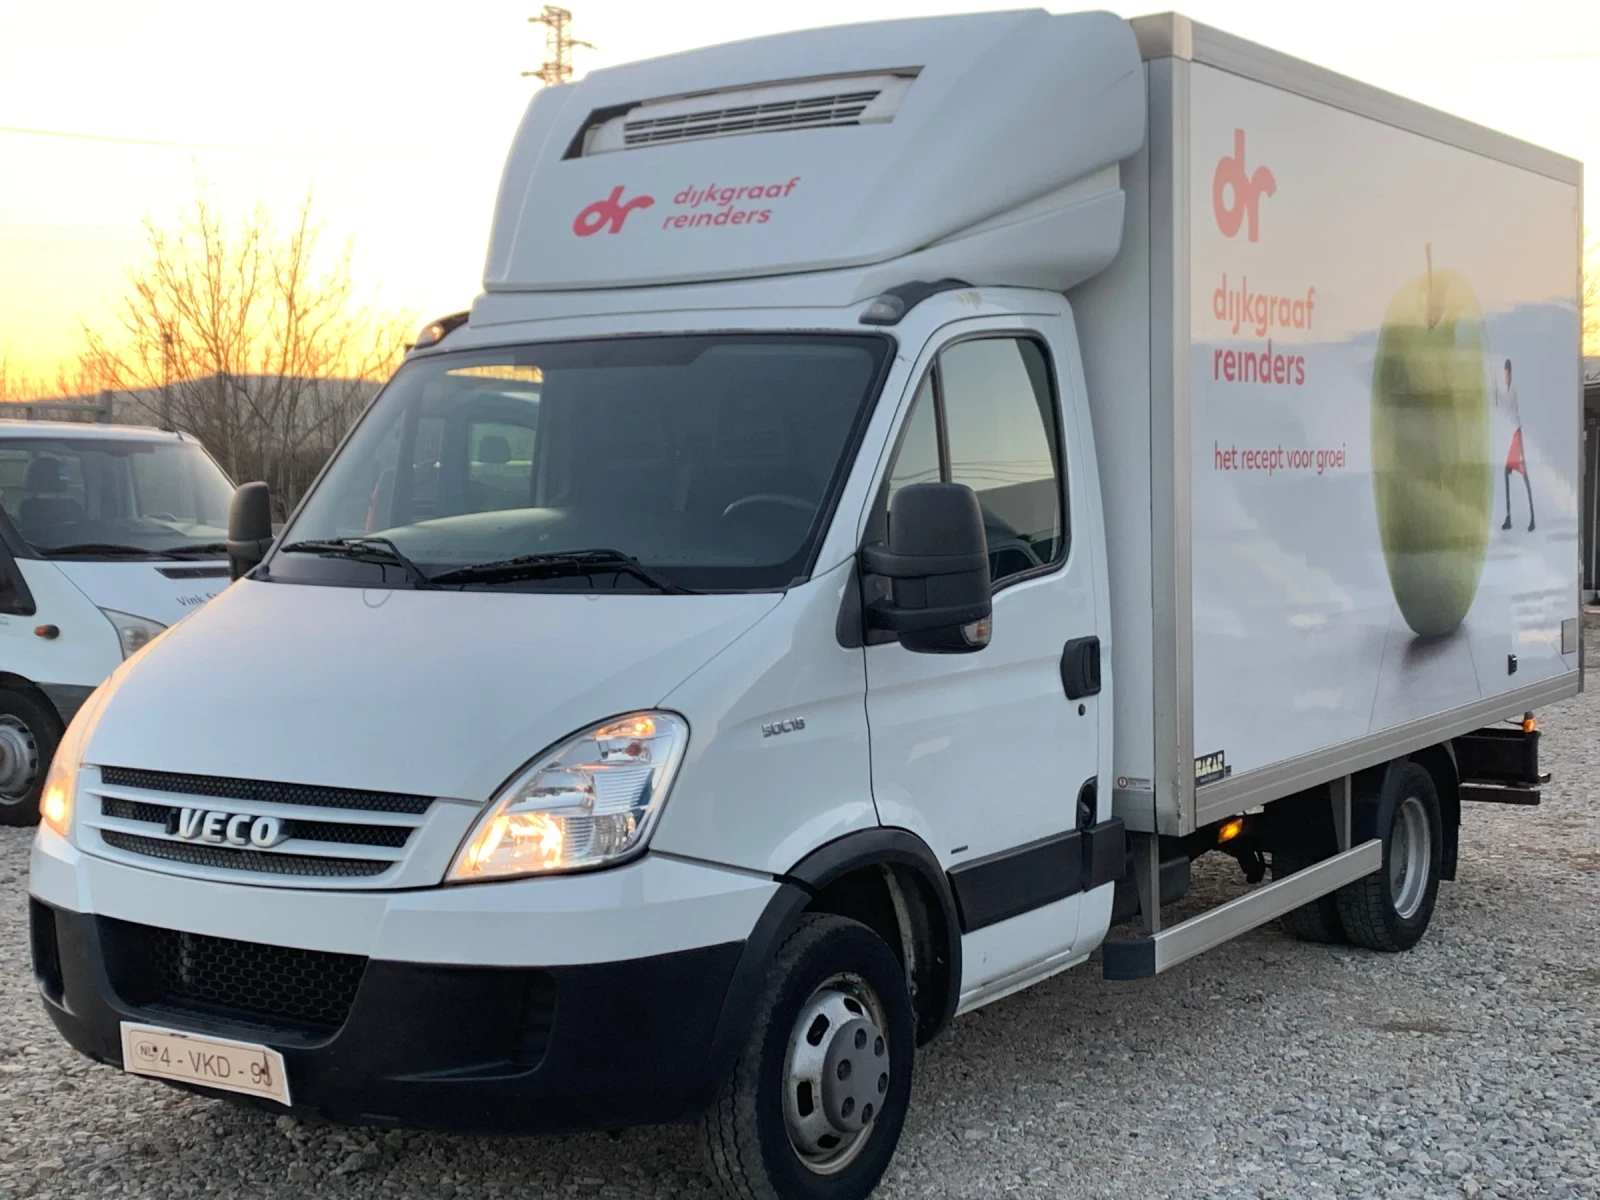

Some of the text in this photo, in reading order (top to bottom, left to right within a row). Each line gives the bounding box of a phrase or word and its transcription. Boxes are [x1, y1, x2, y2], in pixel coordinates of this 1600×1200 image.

[673, 176, 800, 208] dijkgraaf
[662, 205, 773, 230] reinders
[1213, 272, 1315, 337] dijkgraaf
[1214, 338, 1305, 386] reinders
[1215, 440, 1345, 476] het recept voor groei
